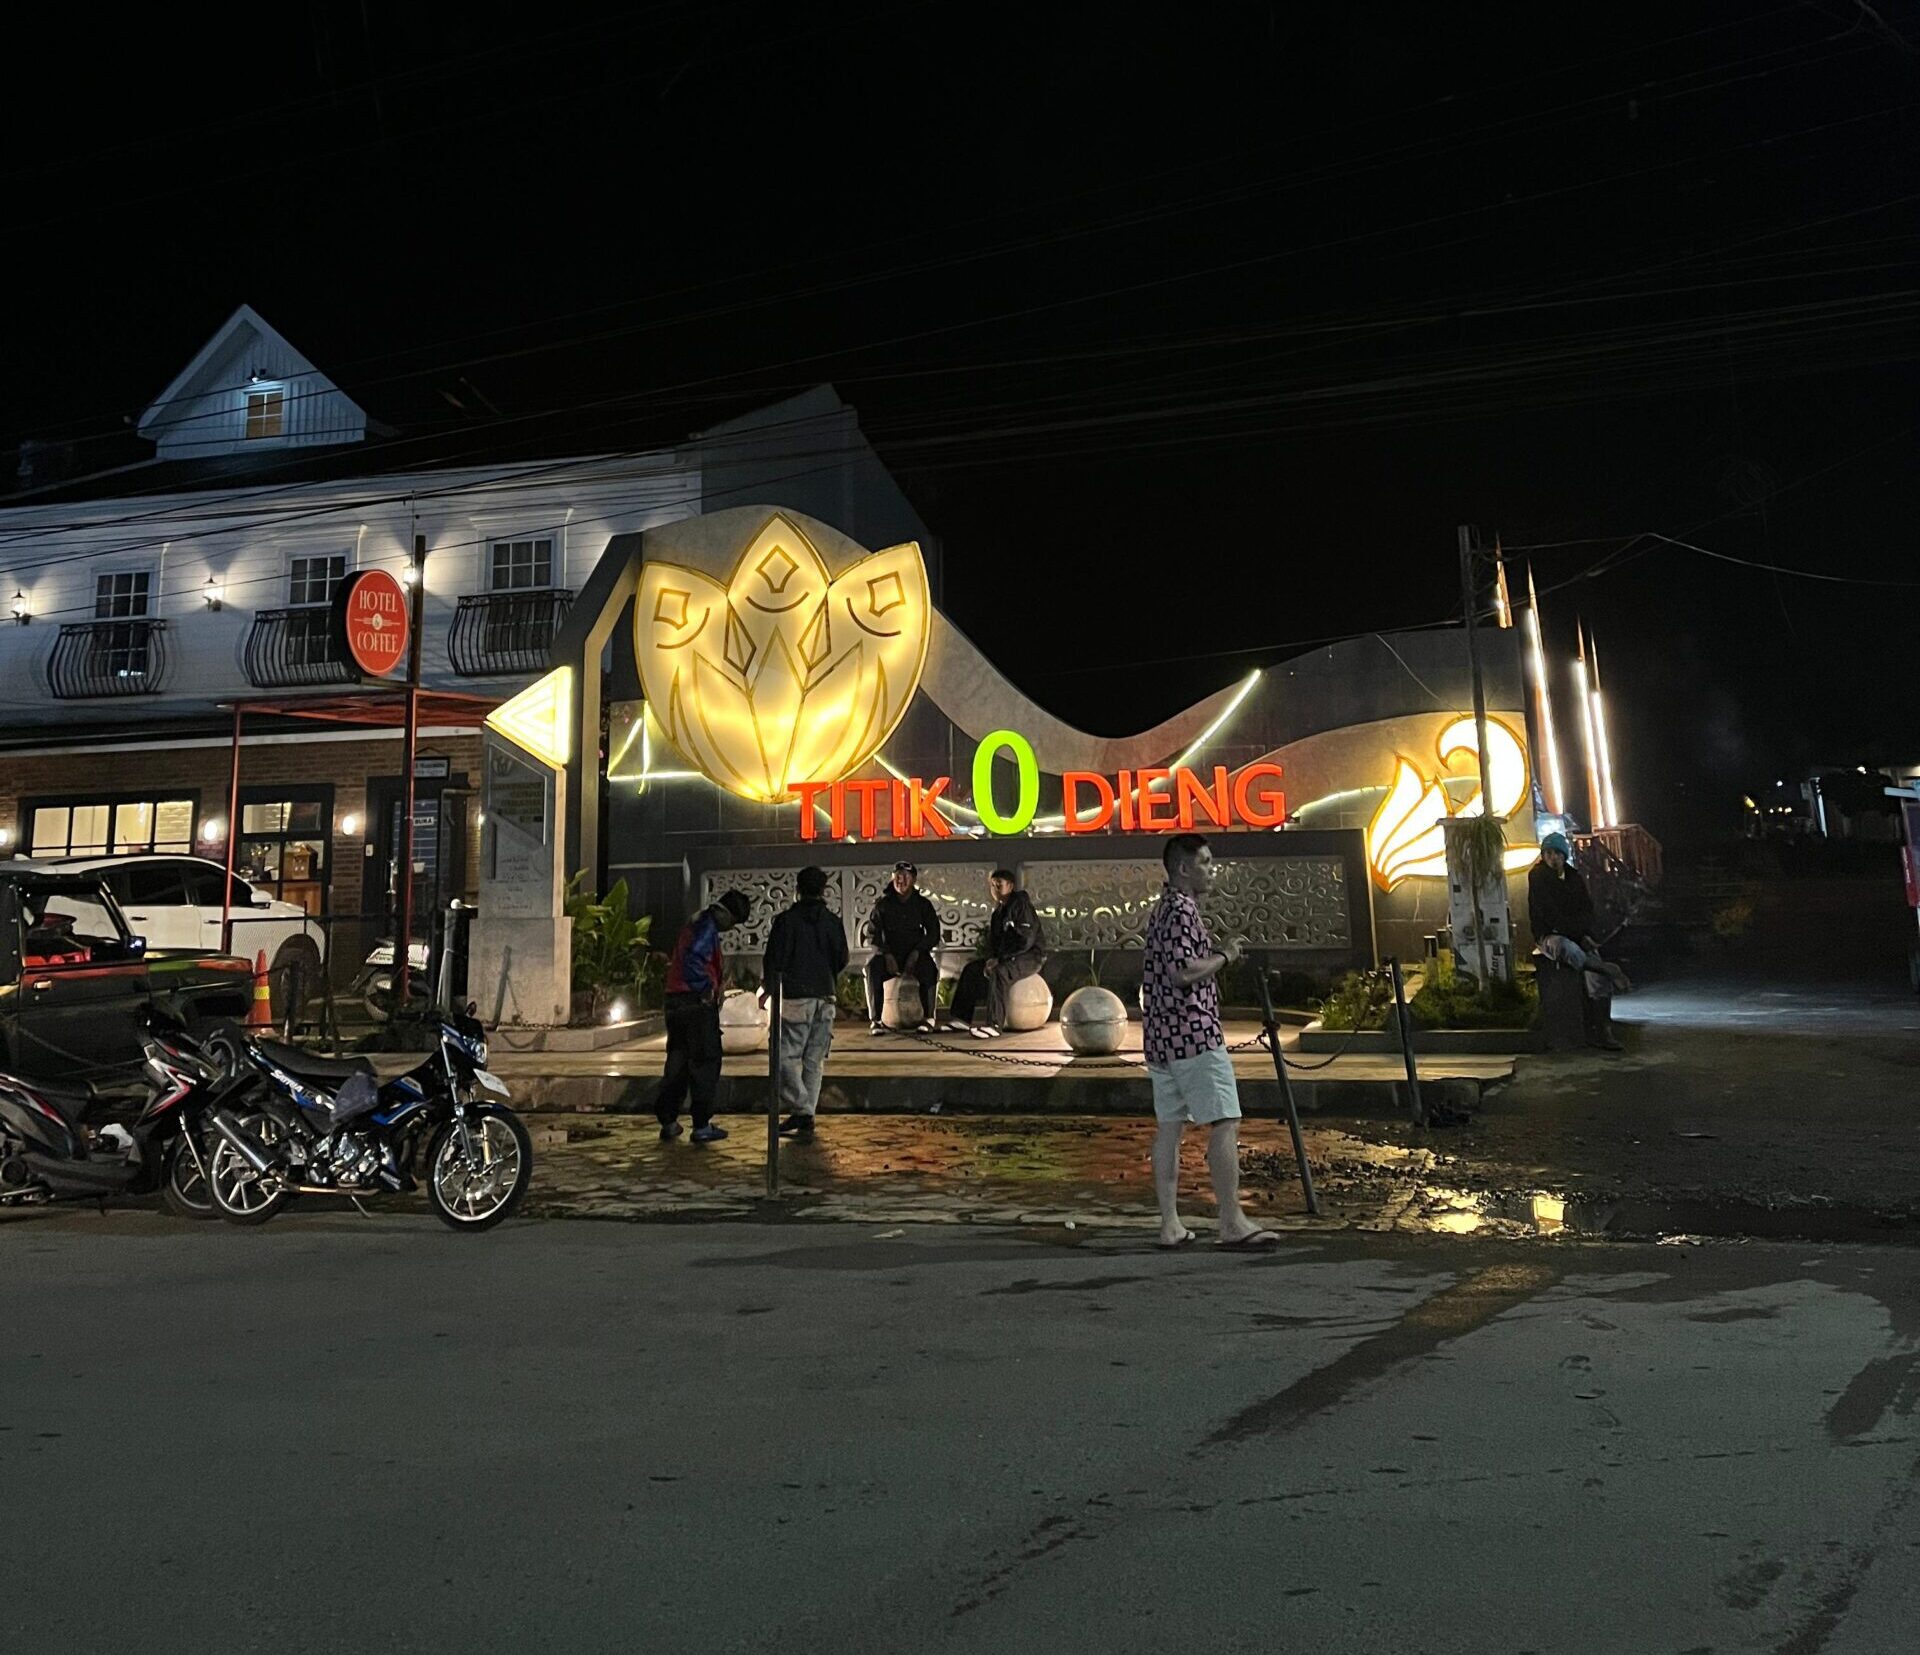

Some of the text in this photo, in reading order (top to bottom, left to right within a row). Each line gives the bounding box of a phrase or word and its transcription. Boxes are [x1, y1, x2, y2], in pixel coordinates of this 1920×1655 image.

[359, 590, 399, 613] HOTEL
[357, 631, 399, 654] COFFEE
[787, 777, 953, 839] TITIK
[1063, 762, 1287, 833] DIENG
